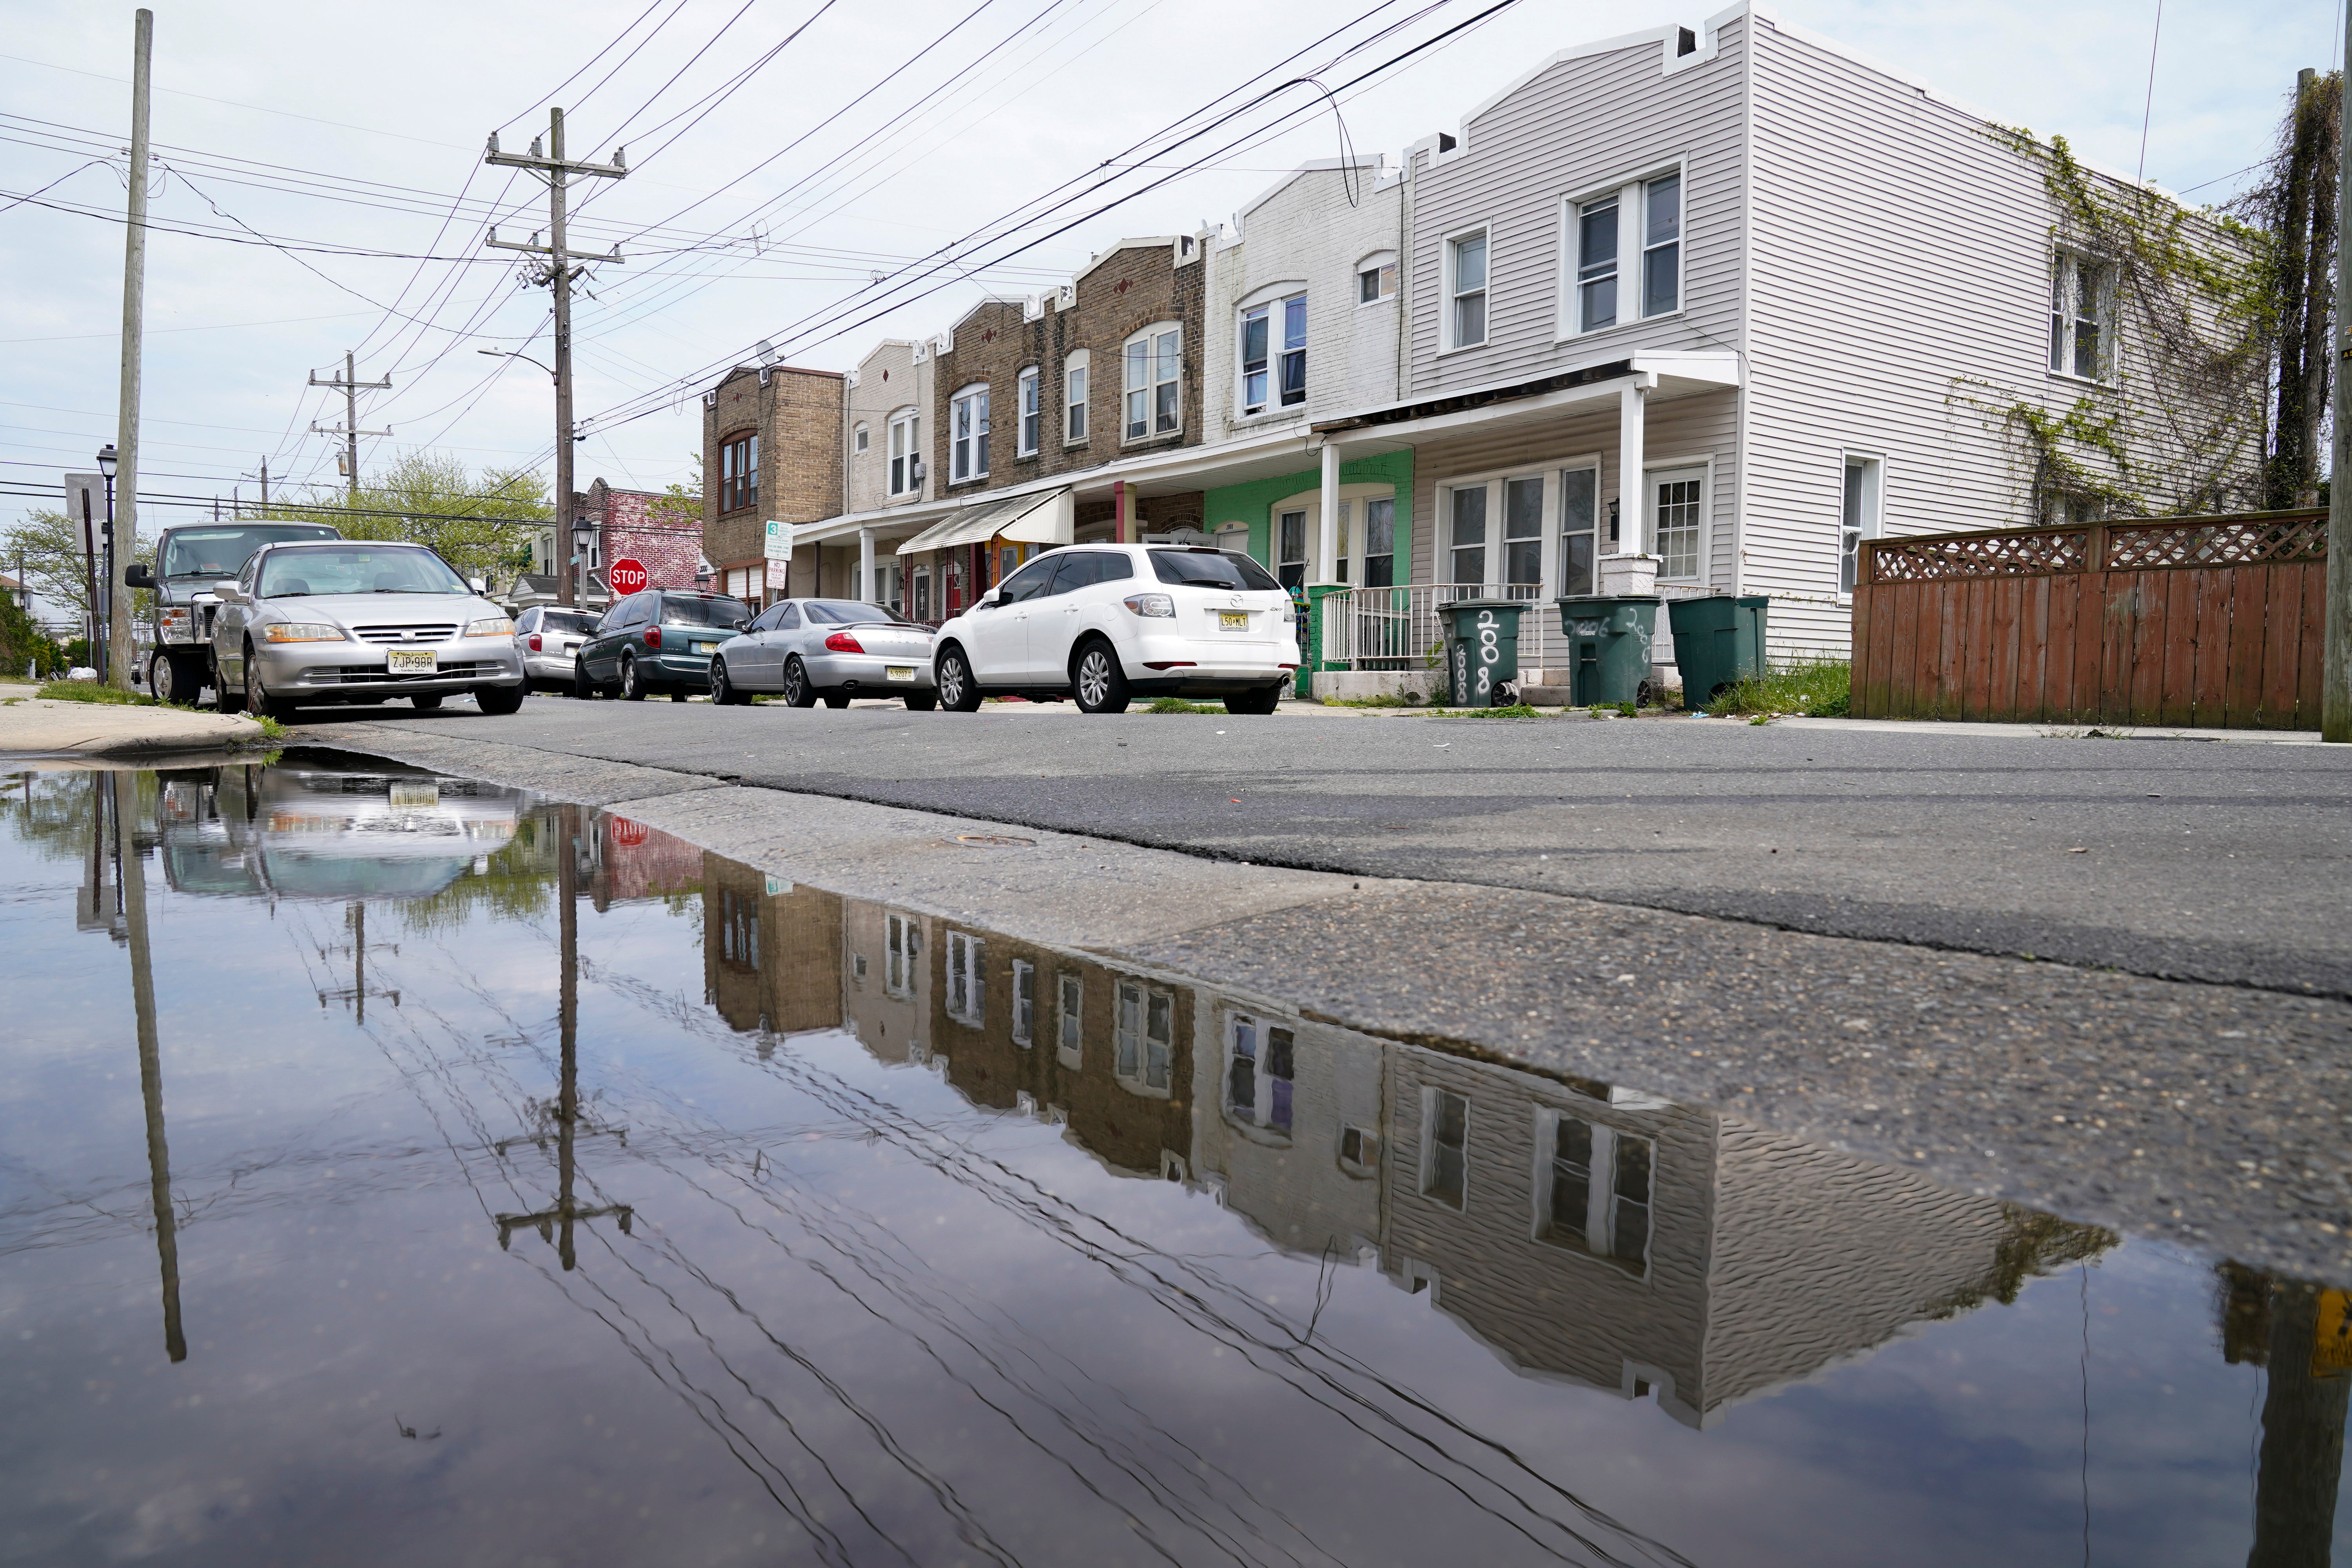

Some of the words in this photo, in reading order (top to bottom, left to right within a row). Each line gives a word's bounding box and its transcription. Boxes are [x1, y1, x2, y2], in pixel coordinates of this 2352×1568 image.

[770, 524, 777, 534] 3
[612, 570, 645, 584] STOP
[1477, 610, 1499, 694] 2008
[1455, 644, 1467, 703] 2008
